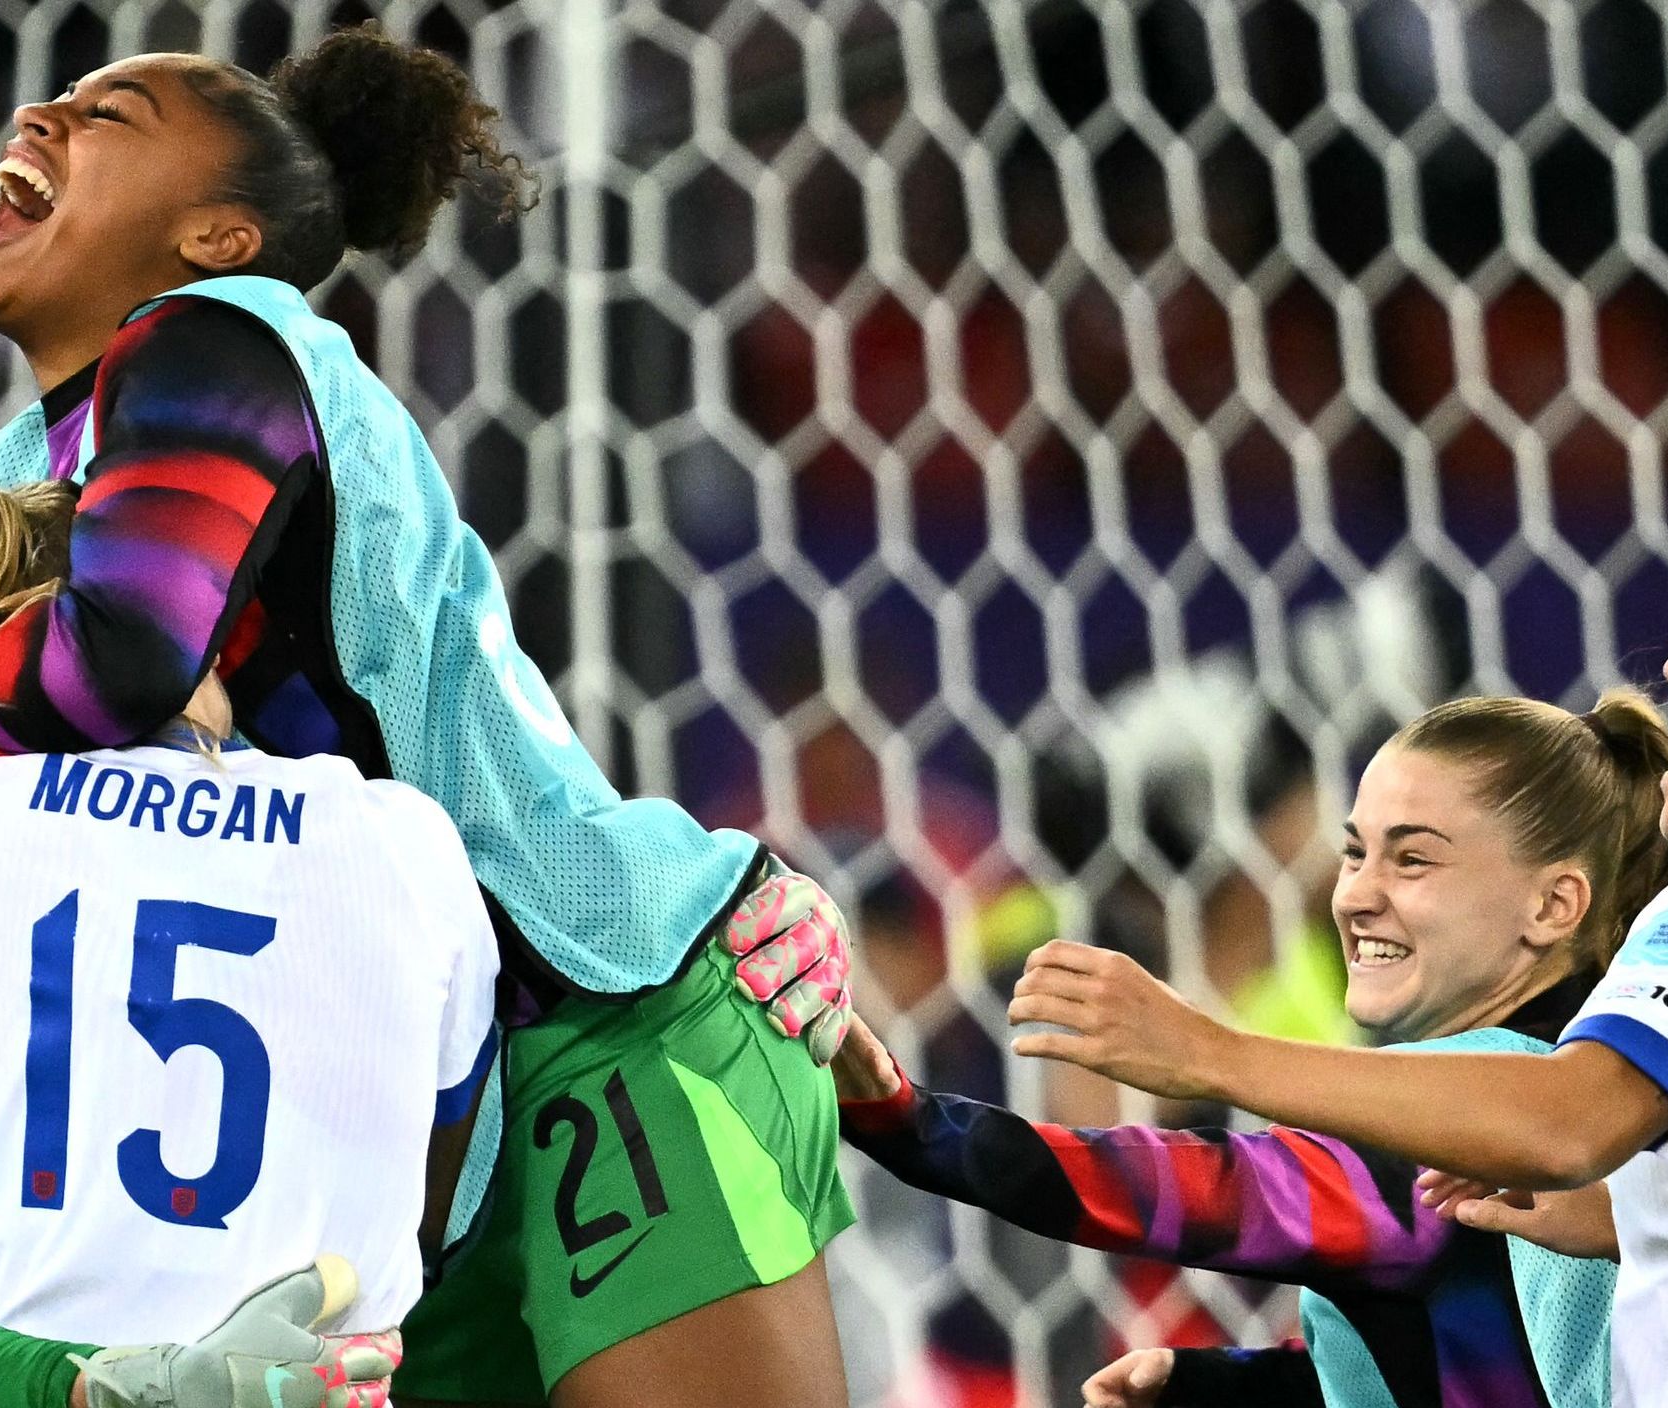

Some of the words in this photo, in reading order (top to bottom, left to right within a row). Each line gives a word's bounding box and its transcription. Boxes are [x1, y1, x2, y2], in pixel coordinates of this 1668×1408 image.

[29, 753, 306, 845] MORGAN
[21, 888, 277, 1230] 15
[533, 1066, 669, 1257] 21
